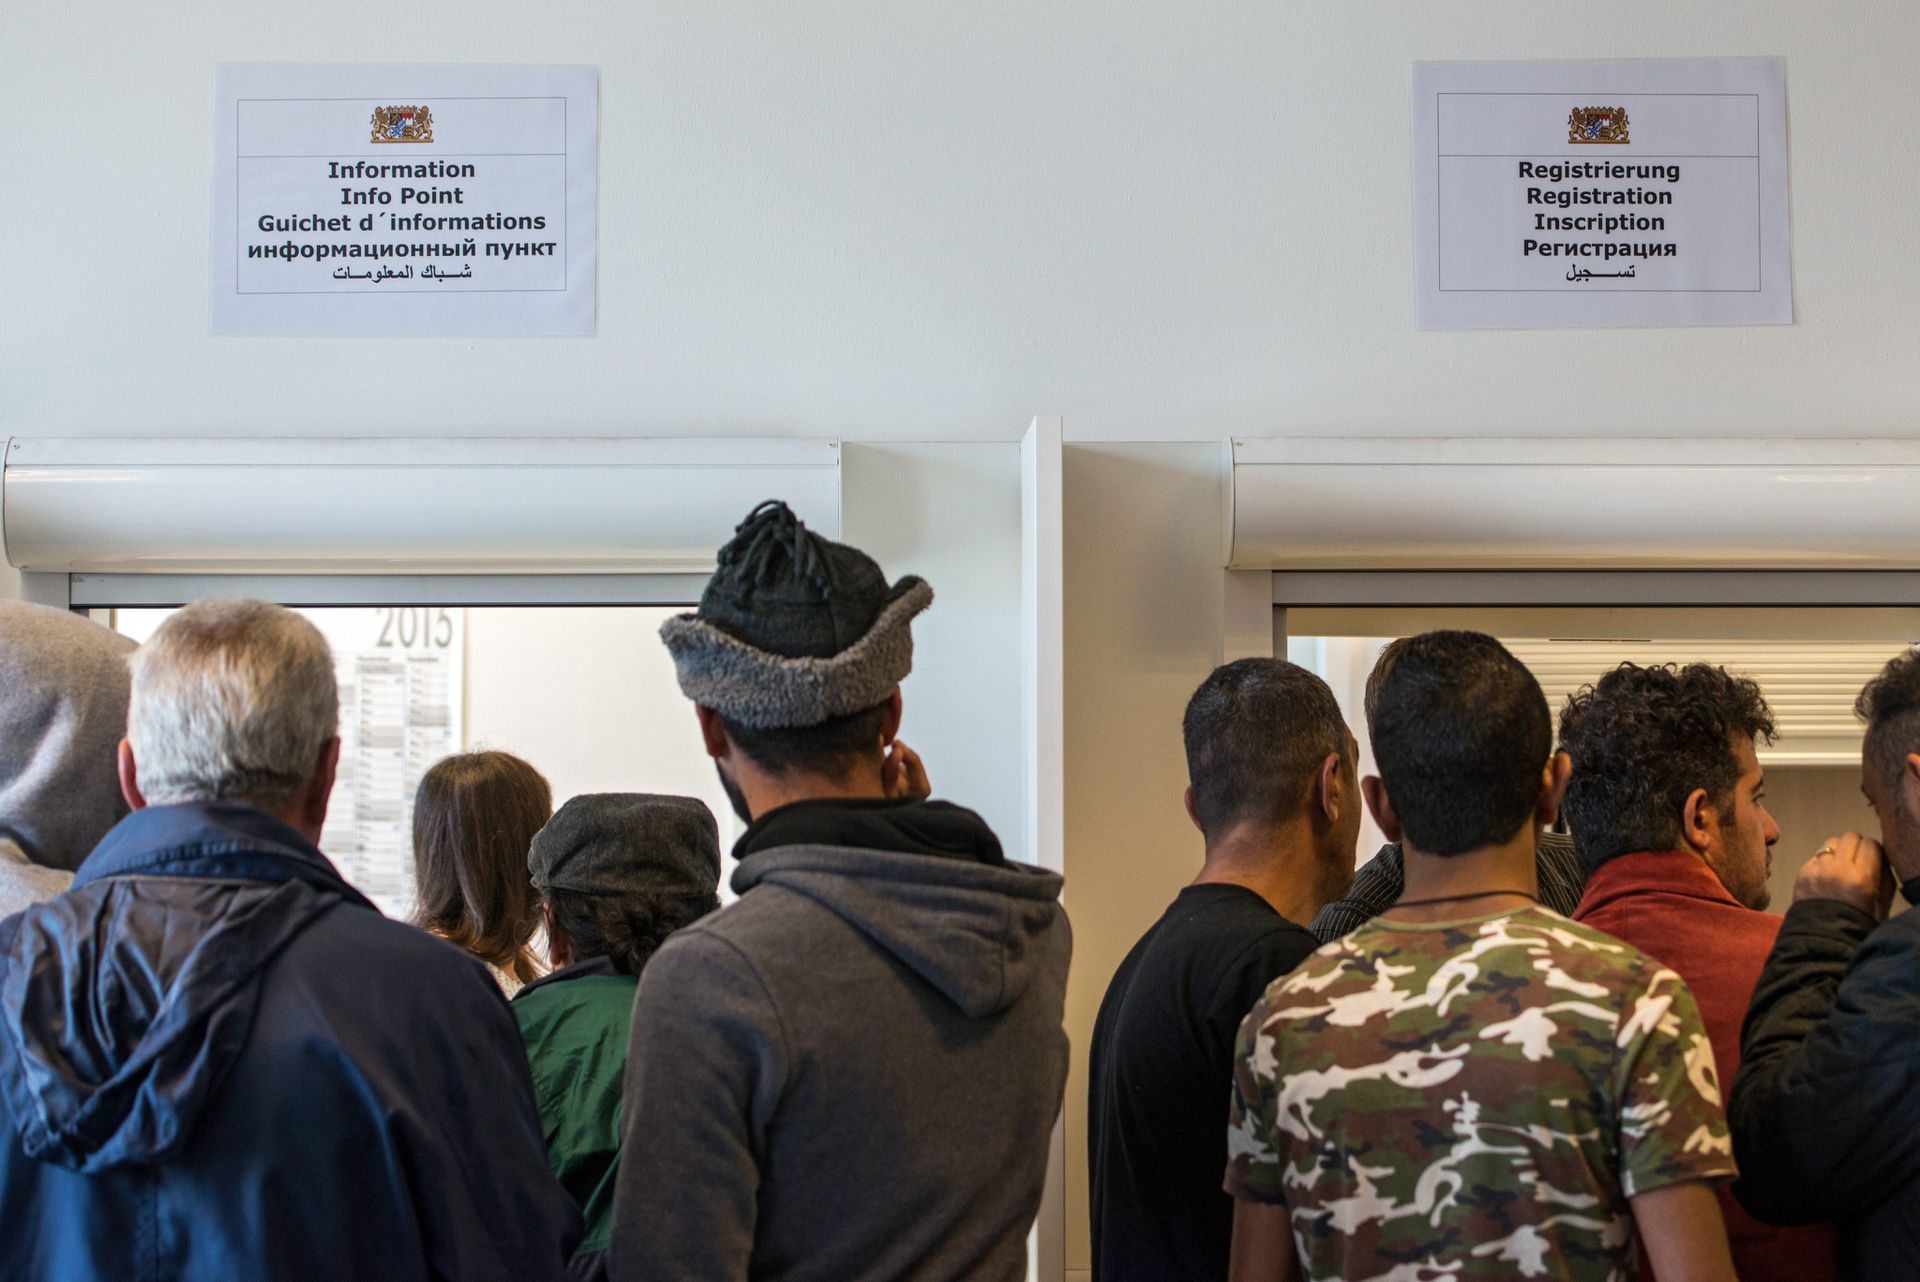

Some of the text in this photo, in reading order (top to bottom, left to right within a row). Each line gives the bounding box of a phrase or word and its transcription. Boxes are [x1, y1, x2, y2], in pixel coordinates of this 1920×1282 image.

[328, 160, 476, 179] Information
[1518, 160, 1681, 183] Registrierung
[340, 187, 464, 205] Info Point
[1526, 186, 1673, 209] Registration
[258, 213, 352, 233] Guichet
[1534, 213, 1666, 235] Inscription
[248, 237, 557, 263] информационный пункт
[1523, 239, 1678, 261] Регистрация
[376, 607, 454, 648] 2015
